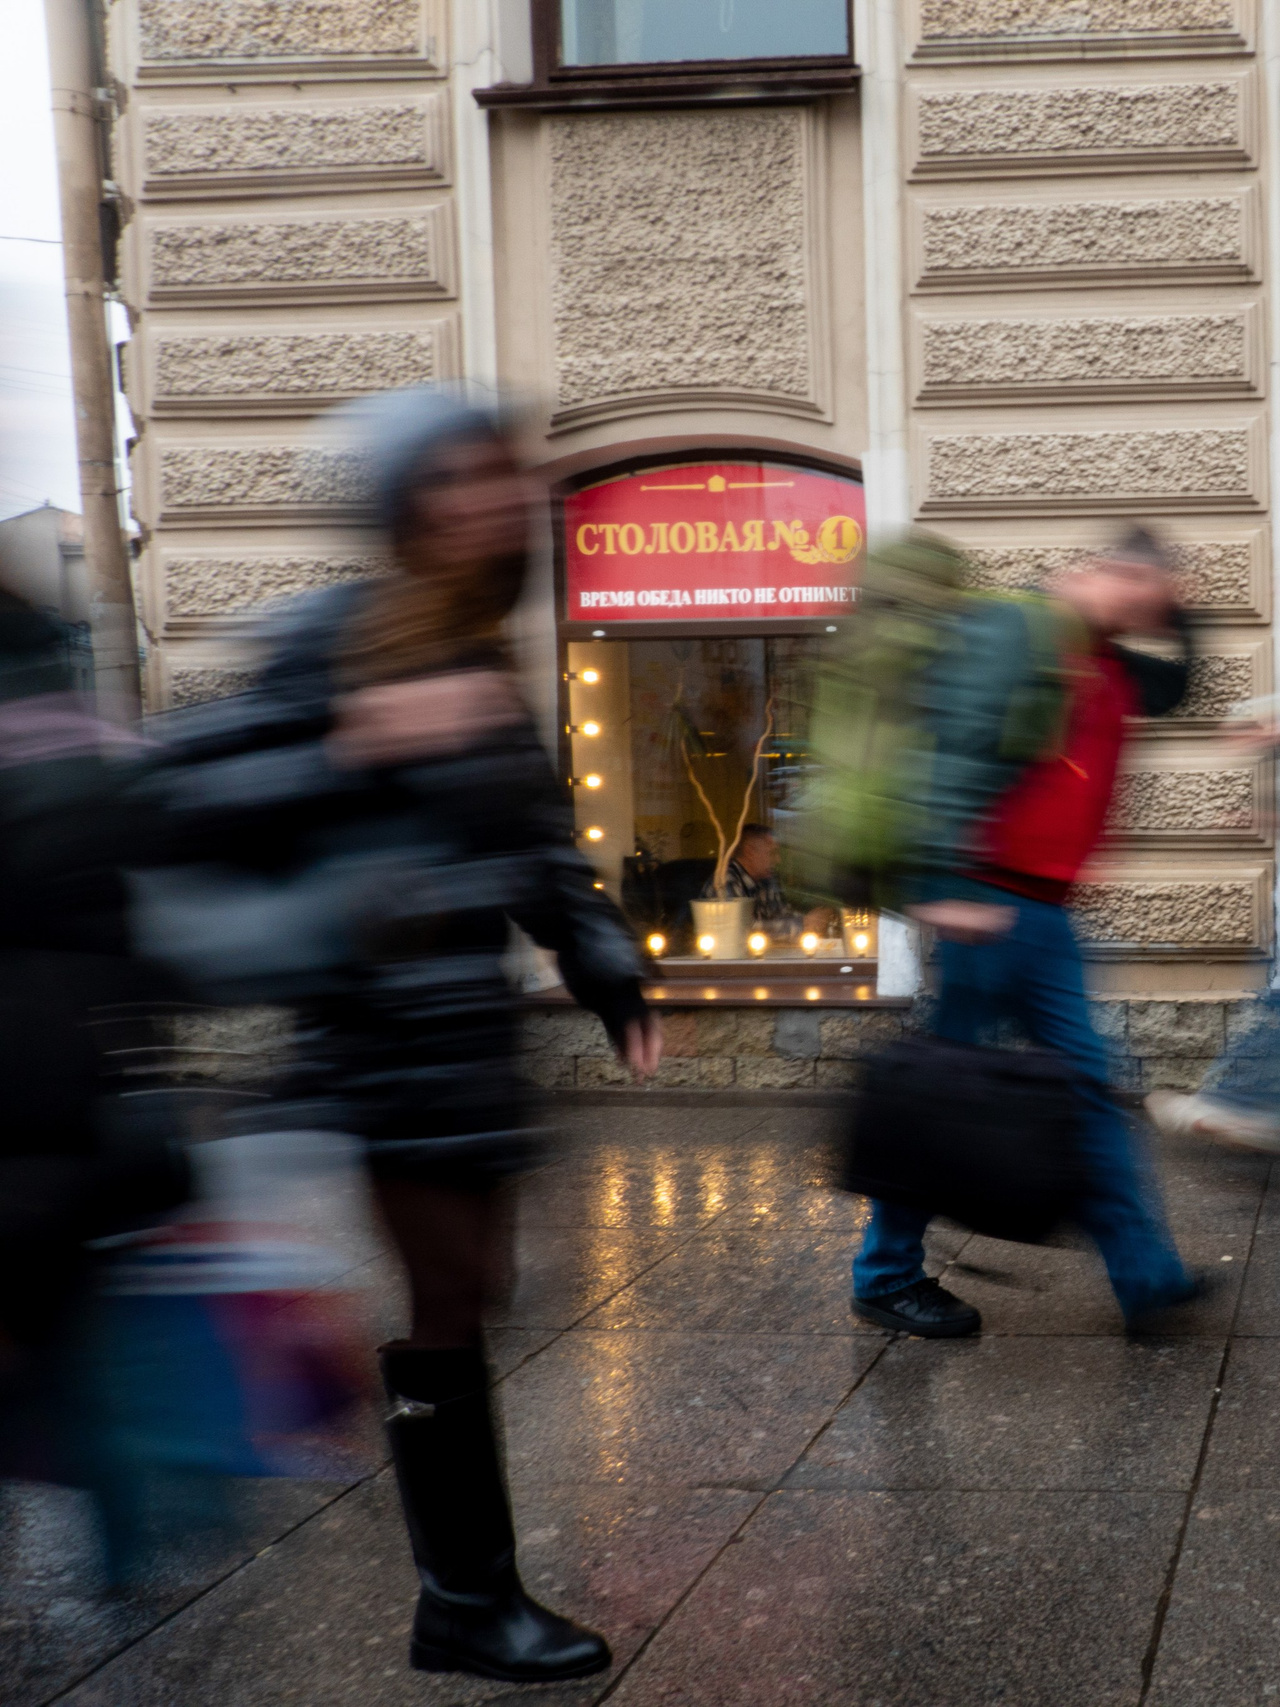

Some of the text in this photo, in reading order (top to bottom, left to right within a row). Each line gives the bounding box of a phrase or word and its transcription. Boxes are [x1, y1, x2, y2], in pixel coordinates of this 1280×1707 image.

[576, 520, 766, 555] СТОЛОВАЯ
[580, 591, 635, 608] ВРЕМЯ
[637, 590, 692, 608] ОБЕДА
[694, 588, 751, 606] НИКТО
[754, 587, 776, 604] НЕ
